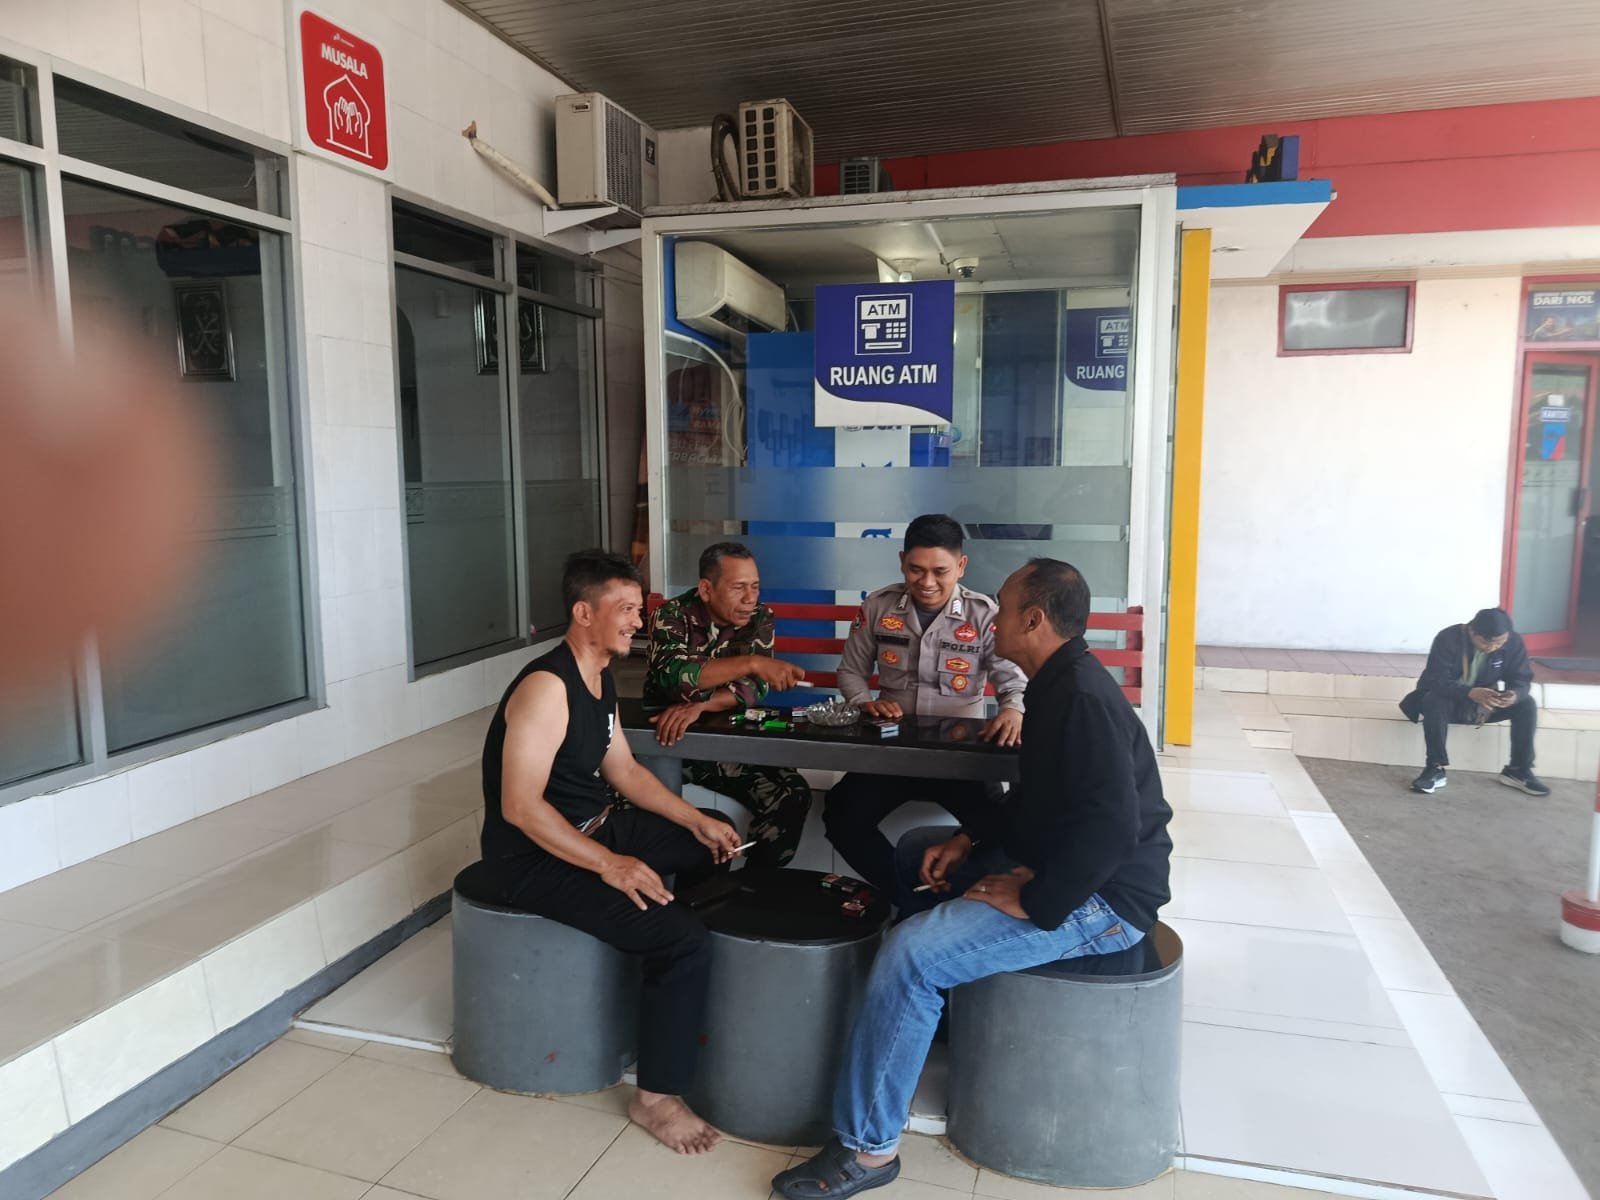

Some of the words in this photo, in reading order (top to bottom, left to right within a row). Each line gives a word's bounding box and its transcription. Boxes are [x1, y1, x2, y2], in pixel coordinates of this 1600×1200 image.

[321, 43, 368, 79] MUSALA
[1566, 295, 1593, 304] NOL
[867, 303, 900, 316] ATM
[830, 365, 895, 385] RUANG
[899, 364, 937, 384] ATM
[1076, 364, 1125, 379] RUANG
[941, 641, 980, 653] POLRI
